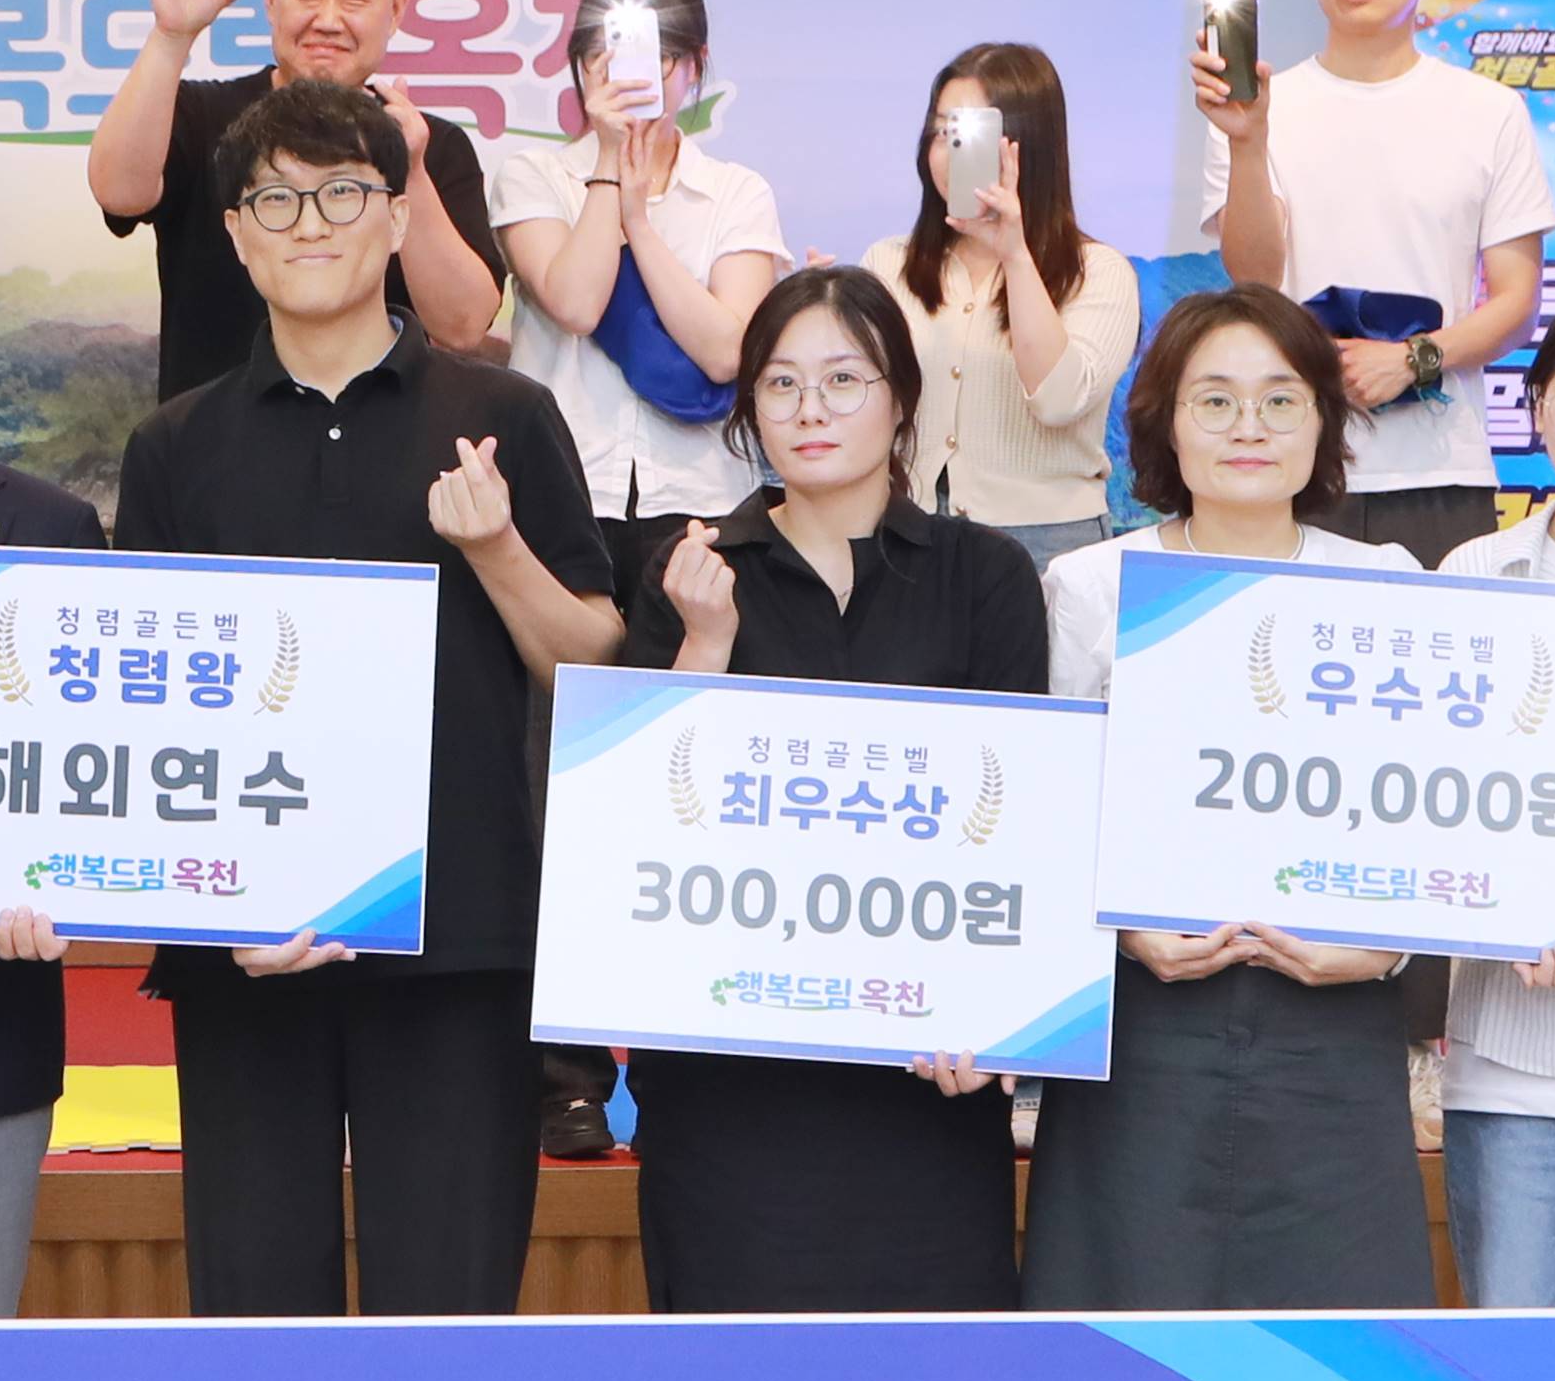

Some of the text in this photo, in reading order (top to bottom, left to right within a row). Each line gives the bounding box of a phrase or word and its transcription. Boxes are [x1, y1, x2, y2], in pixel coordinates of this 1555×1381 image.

[48, 645, 242, 709] 청렴왕
[1305, 661, 1494, 728] 우수상
[719, 771, 950, 840] 최우수상
[49, 853, 238, 896] 행복드림 옥천
[631, 860, 1023, 946] 300,000원
[1299, 859, 1492, 908] 행복드림 옥천
[733, 970, 927, 1017] 행복드림 옥천
